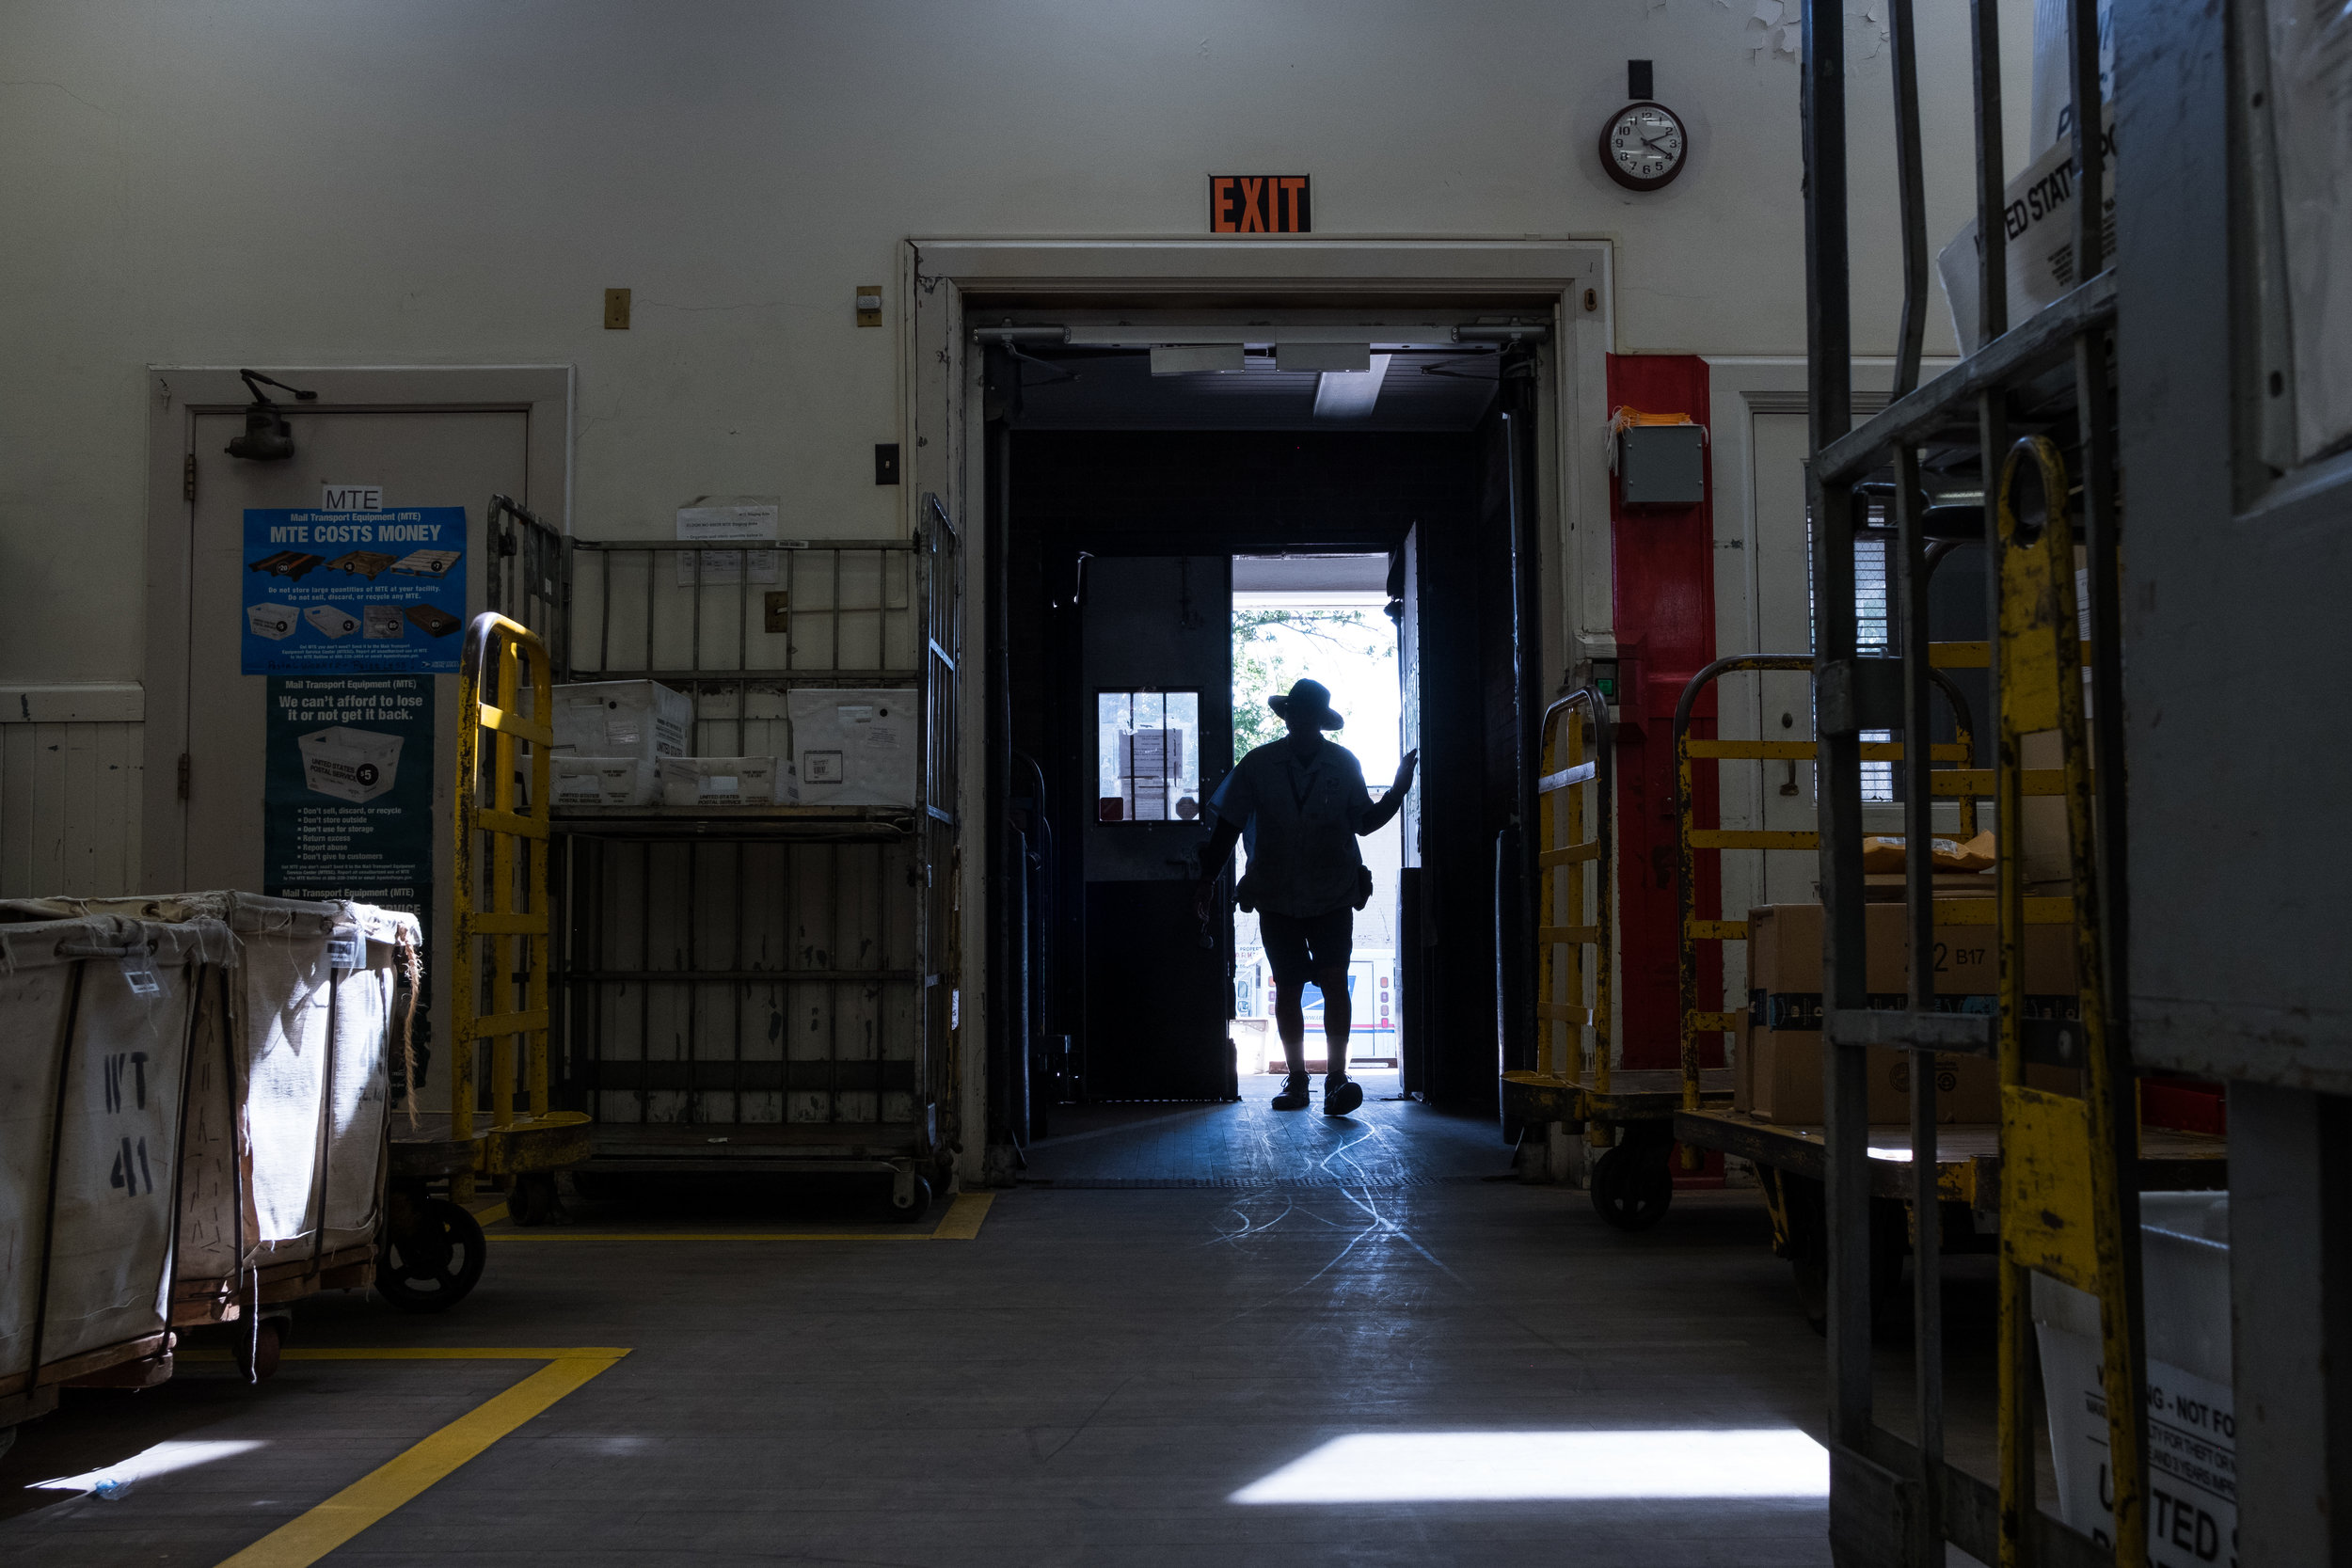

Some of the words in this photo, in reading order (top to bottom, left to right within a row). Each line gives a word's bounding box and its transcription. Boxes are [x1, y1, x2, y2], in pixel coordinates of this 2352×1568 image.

[1642, 112, 1652, 121] 12
[1619, 126, 1630, 135] 10
[1665, 127, 1673, 135] 2
[1616, 138, 1624, 148] 9
[1669, 139, 1677, 148] 3
[1620, 151, 1629, 161] 8
[1664, 152, 1674, 161] 4
[1629, 161, 1637, 170] 7
[1643, 165, 1651, 174] 6
[1655, 162, 1663, 170] 5
[1214, 177, 1306, 232] EXIT
[326, 490, 378, 510] MTE
[291, 514, 309, 522] Mail
[310, 514, 350, 523] Transport
[352, 513, 395, 523] Equipment
[397, 512, 421, 522] (MTE)
[270, 526, 309, 543] MTE
[314, 526, 373, 543] COSTS
[378, 525, 441, 542] MONEY
[311, 586, 329, 594] large
[331, 586, 365, 594] quantities
[415, 585, 441, 594] facility.
[285, 680, 303, 689] Mail
[306, 680, 345, 689] Transport
[347, 679, 390, 689] Equipment
[392, 679, 417, 689] (MTE)
[278, 695, 298, 707] We
[301, 695, 334, 707] can't
[337, 695, 377, 707] afford
[380, 695, 393, 707] to
[397, 694, 423, 706] lose
[288, 709, 297, 721] it
[300, 711, 314, 721] or
[317, 709, 339, 721] not
[342, 709, 362, 723] get
[365, 708, 374, 721] it
[378, 708, 413, 721] back.
[311, 758, 332, 769] UNITED
[332, 763, 355, 774] STATES
[310, 765, 332, 777] POSTAL
[332, 769, 358, 783] SERVIC
[359, 768, 372, 781] $5
[376, 807, 402, 816] recycle
[323, 853, 337, 862] give
[281, 889, 300, 897] Mail
[301, 888, 342, 898] Transport
[344, 888, 389, 898] Equipment
[389, 888, 415, 897] (MTE)
[1956, 949, 1986, 965] B17
[110, 1136, 153, 1197] 41
[2176, 1395, 2208, 1427] NOT
[2212, 1409, 2235, 1438] FO
